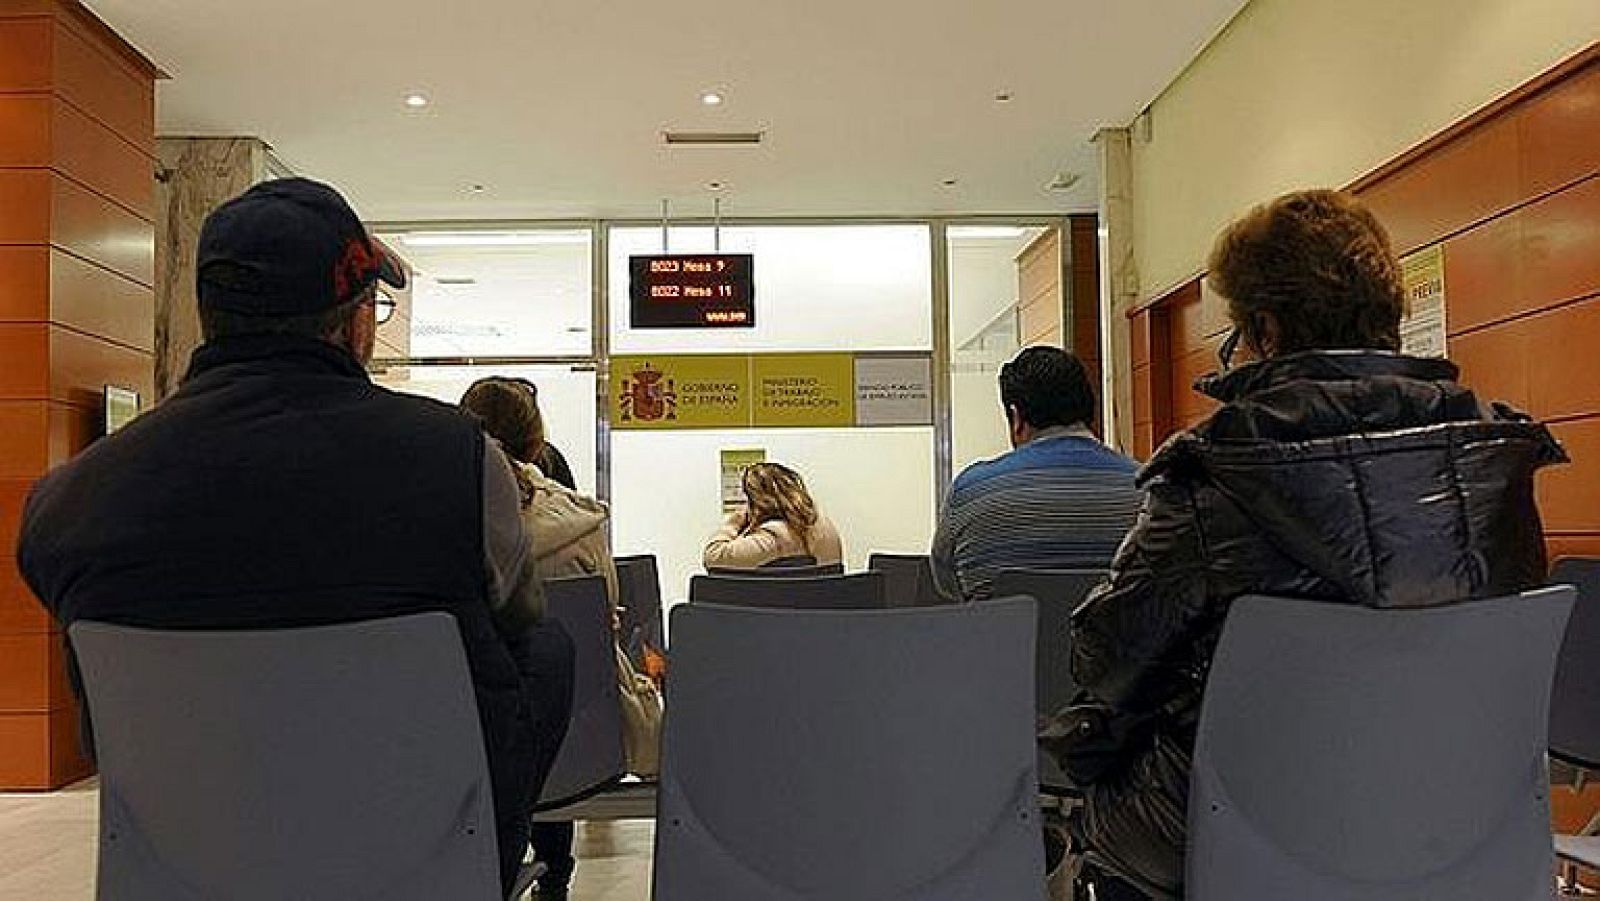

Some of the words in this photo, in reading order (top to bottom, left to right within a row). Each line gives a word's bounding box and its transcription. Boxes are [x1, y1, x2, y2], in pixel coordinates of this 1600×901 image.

[718, 285, 732, 296] 11
[681, 383, 739, 392] GOBIERNO
[682, 395, 697, 405] DE
